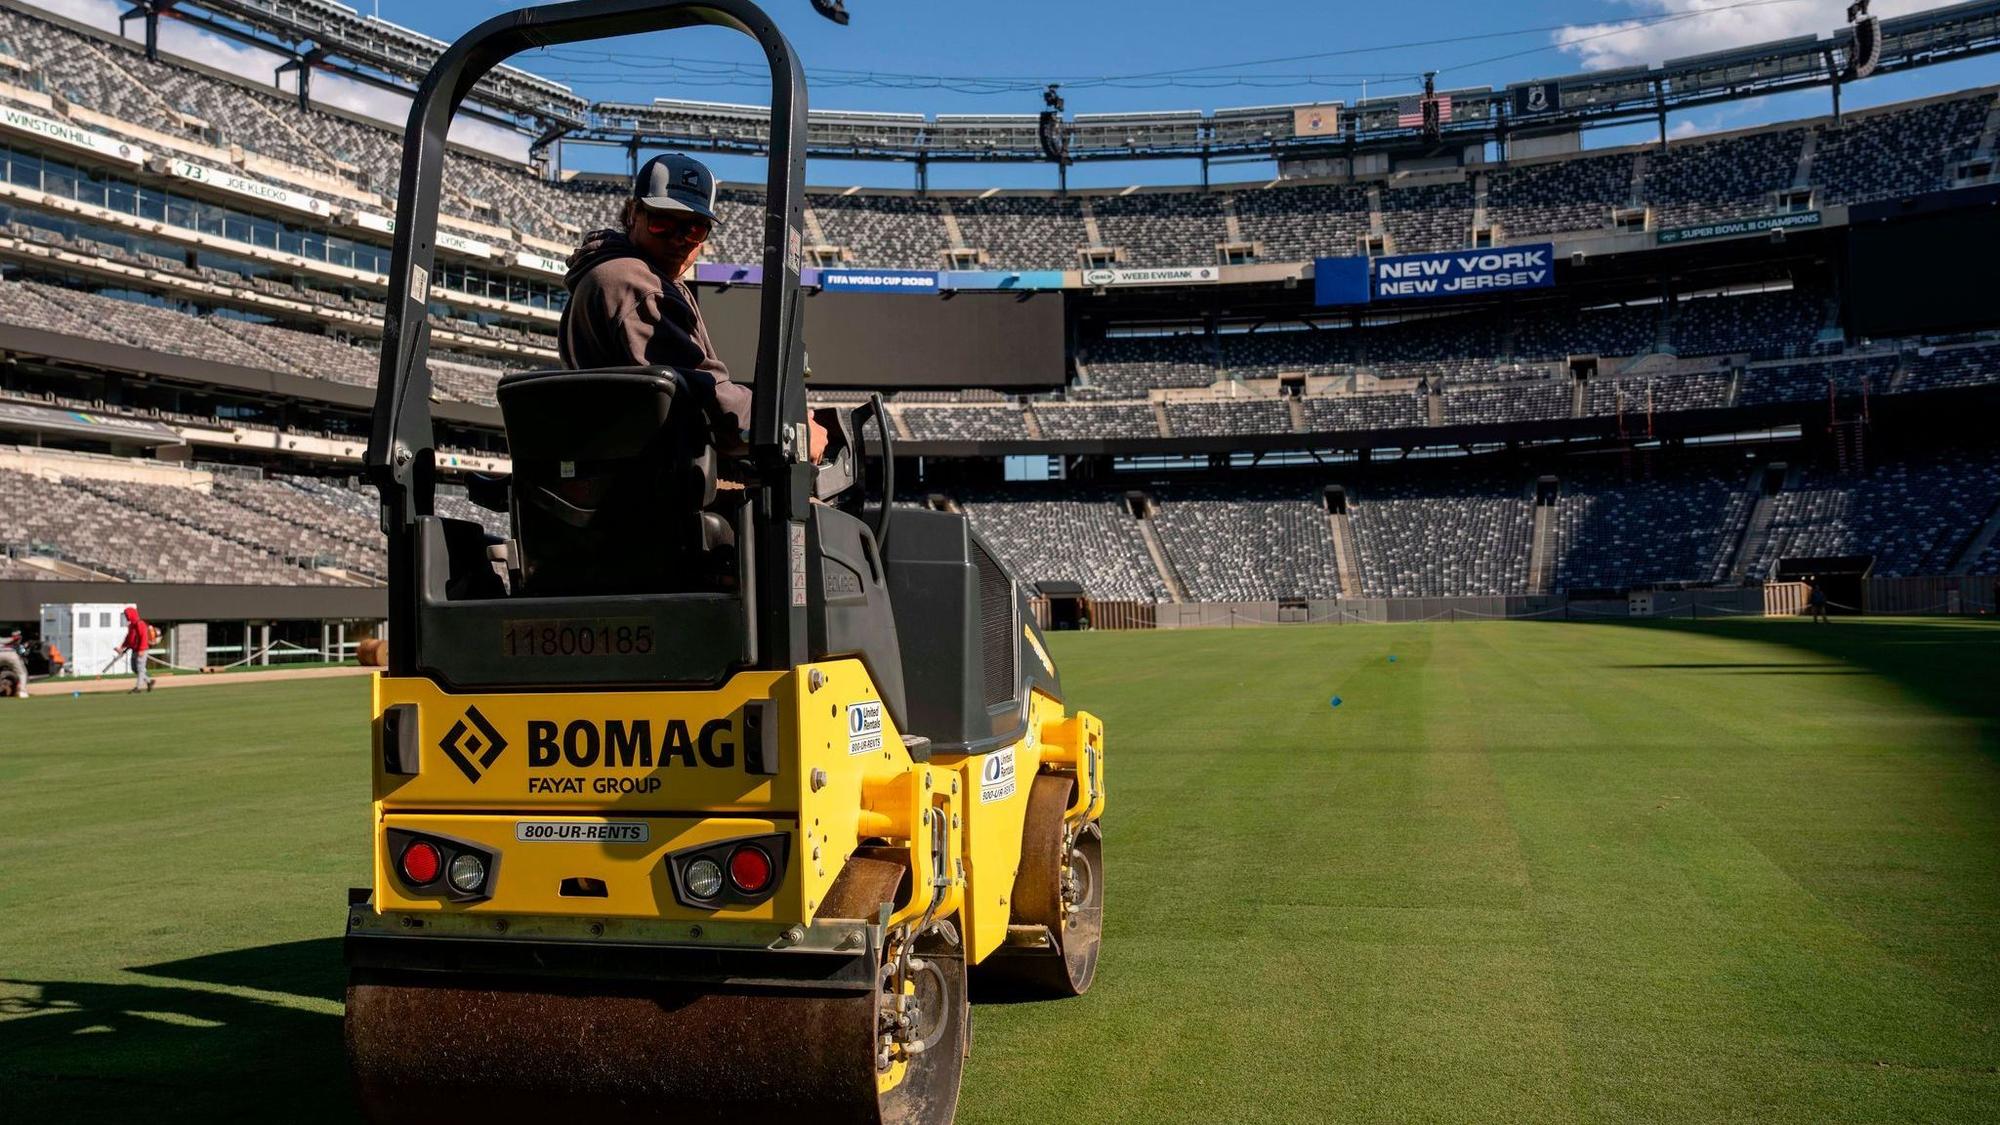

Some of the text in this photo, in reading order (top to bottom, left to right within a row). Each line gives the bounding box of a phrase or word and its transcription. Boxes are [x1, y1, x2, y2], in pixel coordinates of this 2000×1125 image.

[5, 111, 96, 147] WINSTON HILL
[183, 164, 201, 179] 73
[226, 178, 287, 202] JOE KLECKO
[1680, 226, 1714, 240] SUPER
[1715, 223, 1747, 235] BOWL
[1748, 221, 1757, 231] III
[1757, 213, 1819, 230] CHAMPIONS
[441, 235, 466, 249] LYONS
[541, 259, 554, 270] 74
[1379, 250, 1547, 279] NEW YORK
[827, 275, 934, 287] FIFA WORLD CUP 2026
[1121, 270, 1192, 281] WEEB EWBANK
[1380, 270, 1547, 296] NEW JERSEY
[505, 625, 652, 656] 11800185
[863, 705, 880, 719] United
[863, 718, 881, 731] Rentals
[527, 718, 736, 769] BOMAG
[851, 737, 881, 753] 800-UR-RENTS
[1001, 750, 1013, 766] United
[1001, 764, 1014, 778] Rentals
[528, 777, 662, 795] FAYAT GROUP
[524, 824, 642, 840] 800-UR-RENTS
